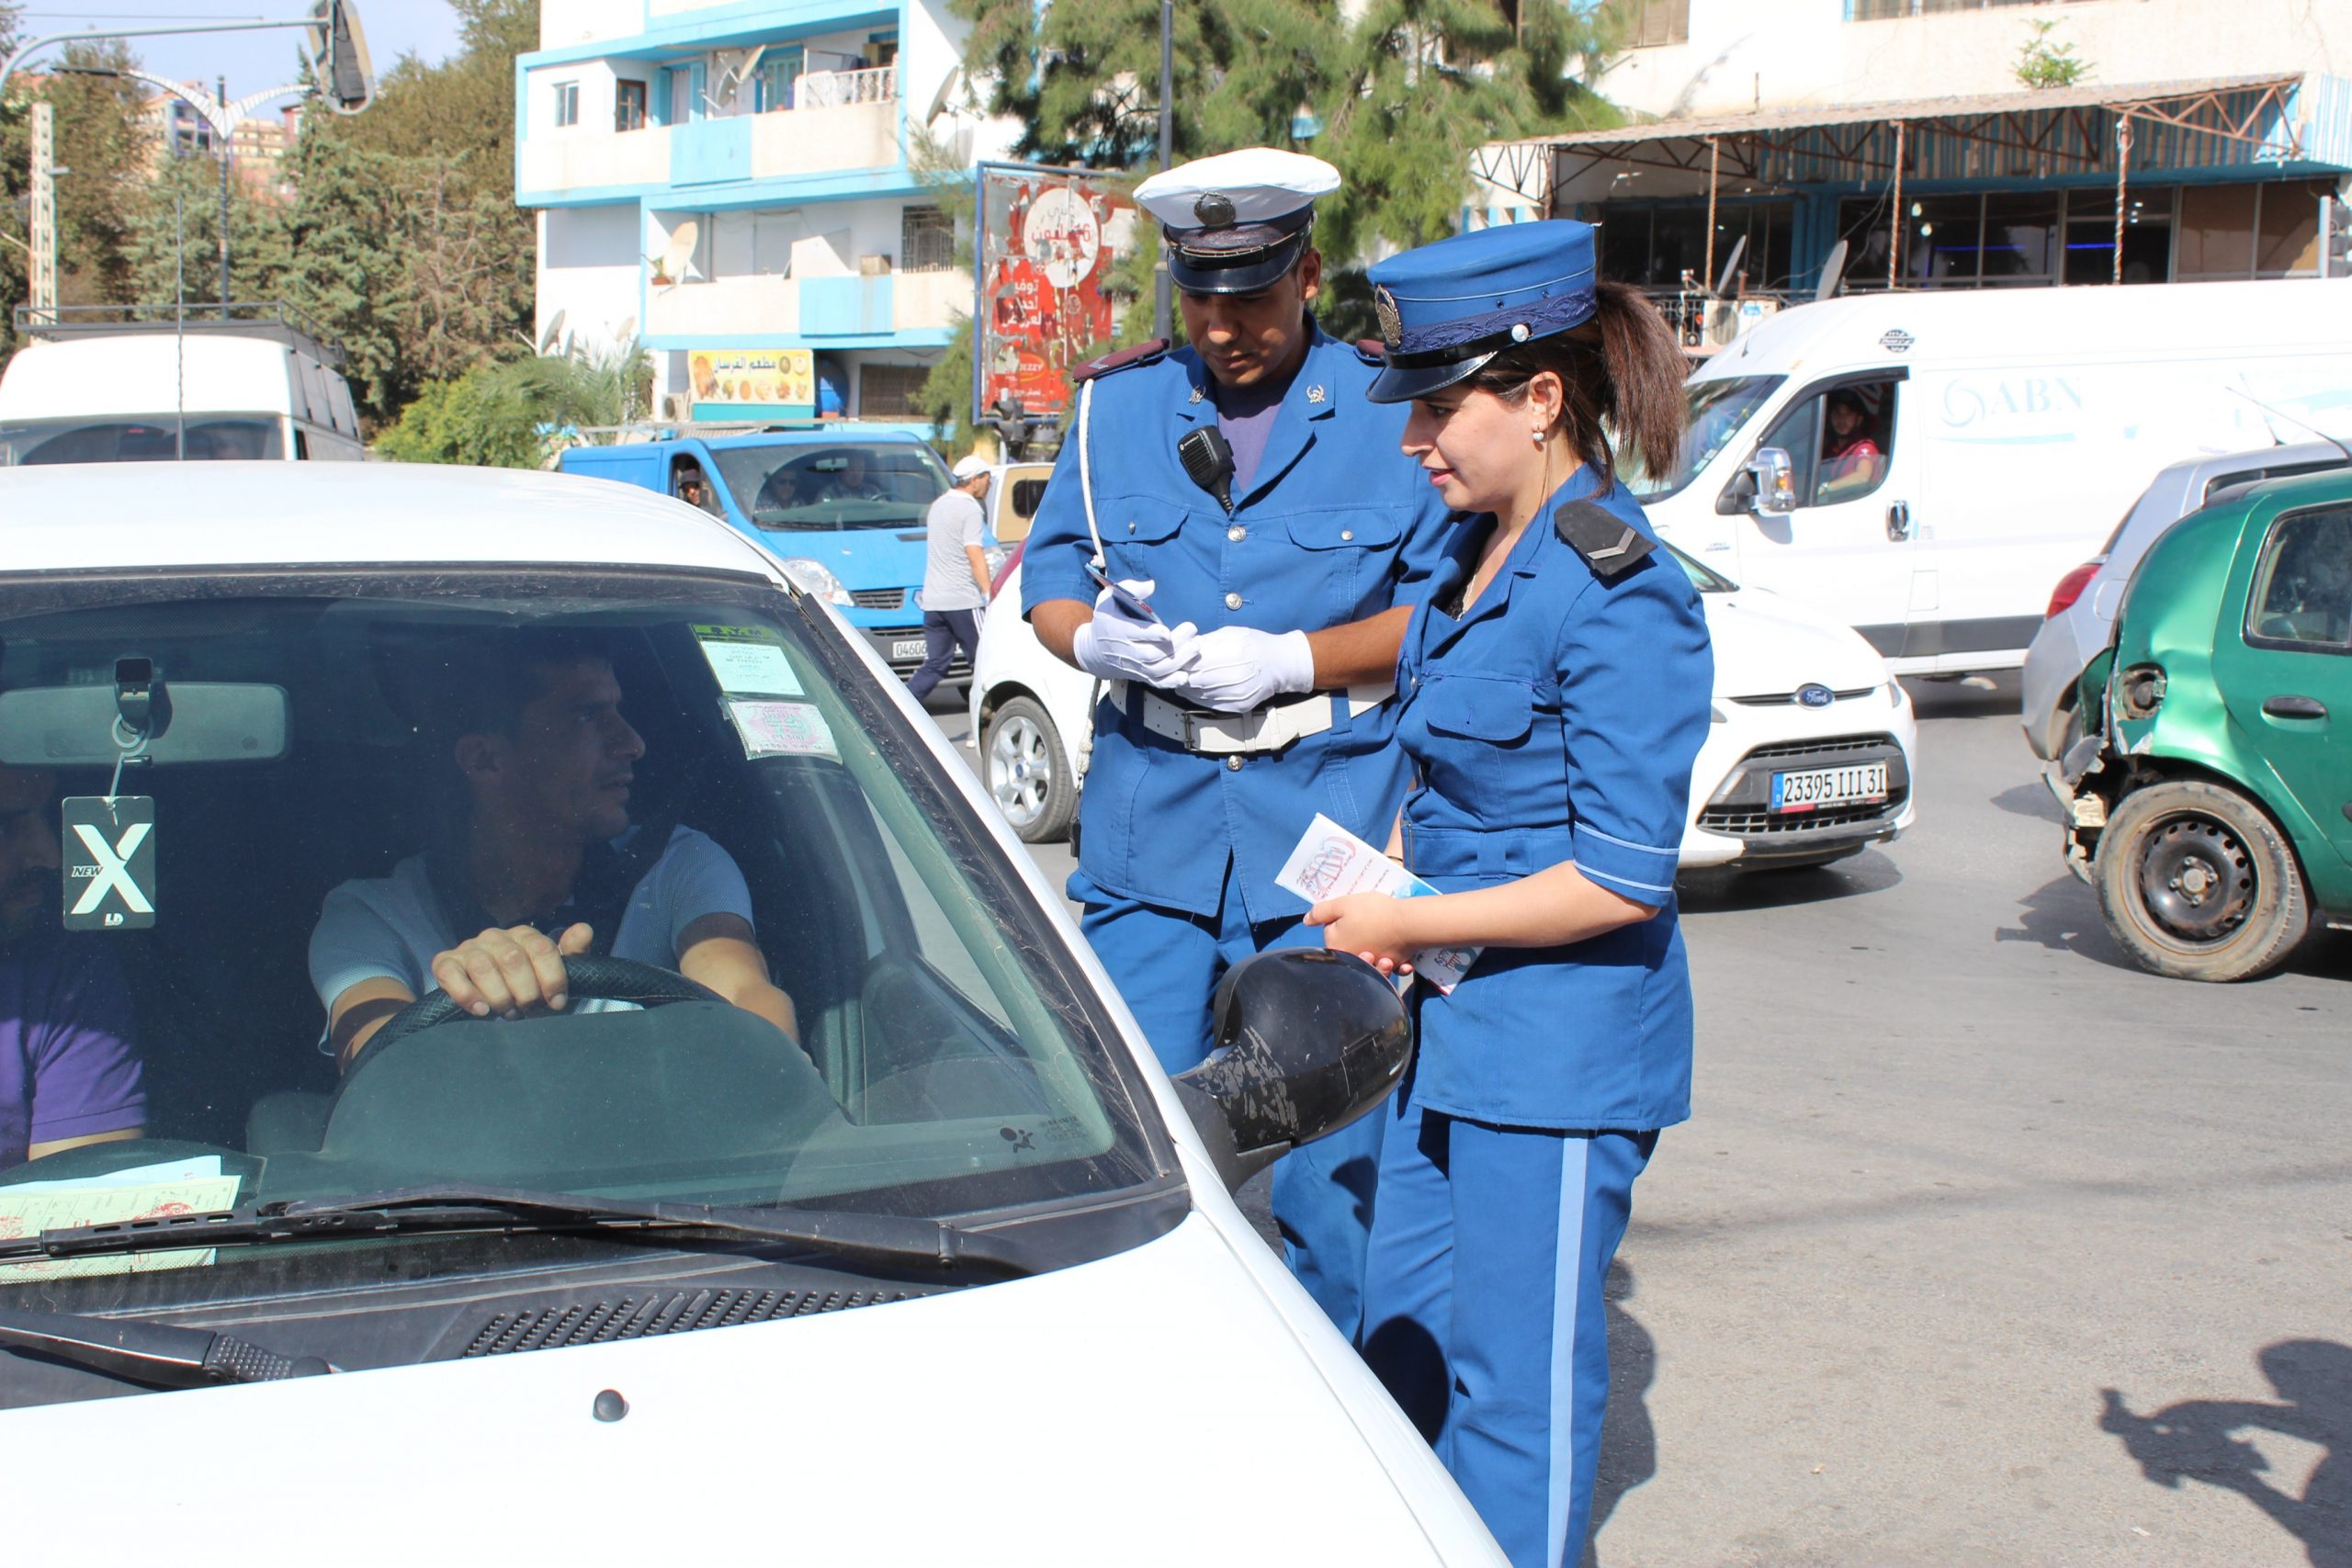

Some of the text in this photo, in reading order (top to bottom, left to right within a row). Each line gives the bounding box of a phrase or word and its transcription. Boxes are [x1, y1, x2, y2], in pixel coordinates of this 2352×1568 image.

[749, 355, 776, 372] مطعم
[1989, 376, 2083, 415] ABN
[1806, 690, 1829, 705] Ford
[1784, 773, 1833, 803] 23395
[70, 823, 155, 914] X
[72, 865, 103, 878] NEW
[104, 913, 124, 926] LD
